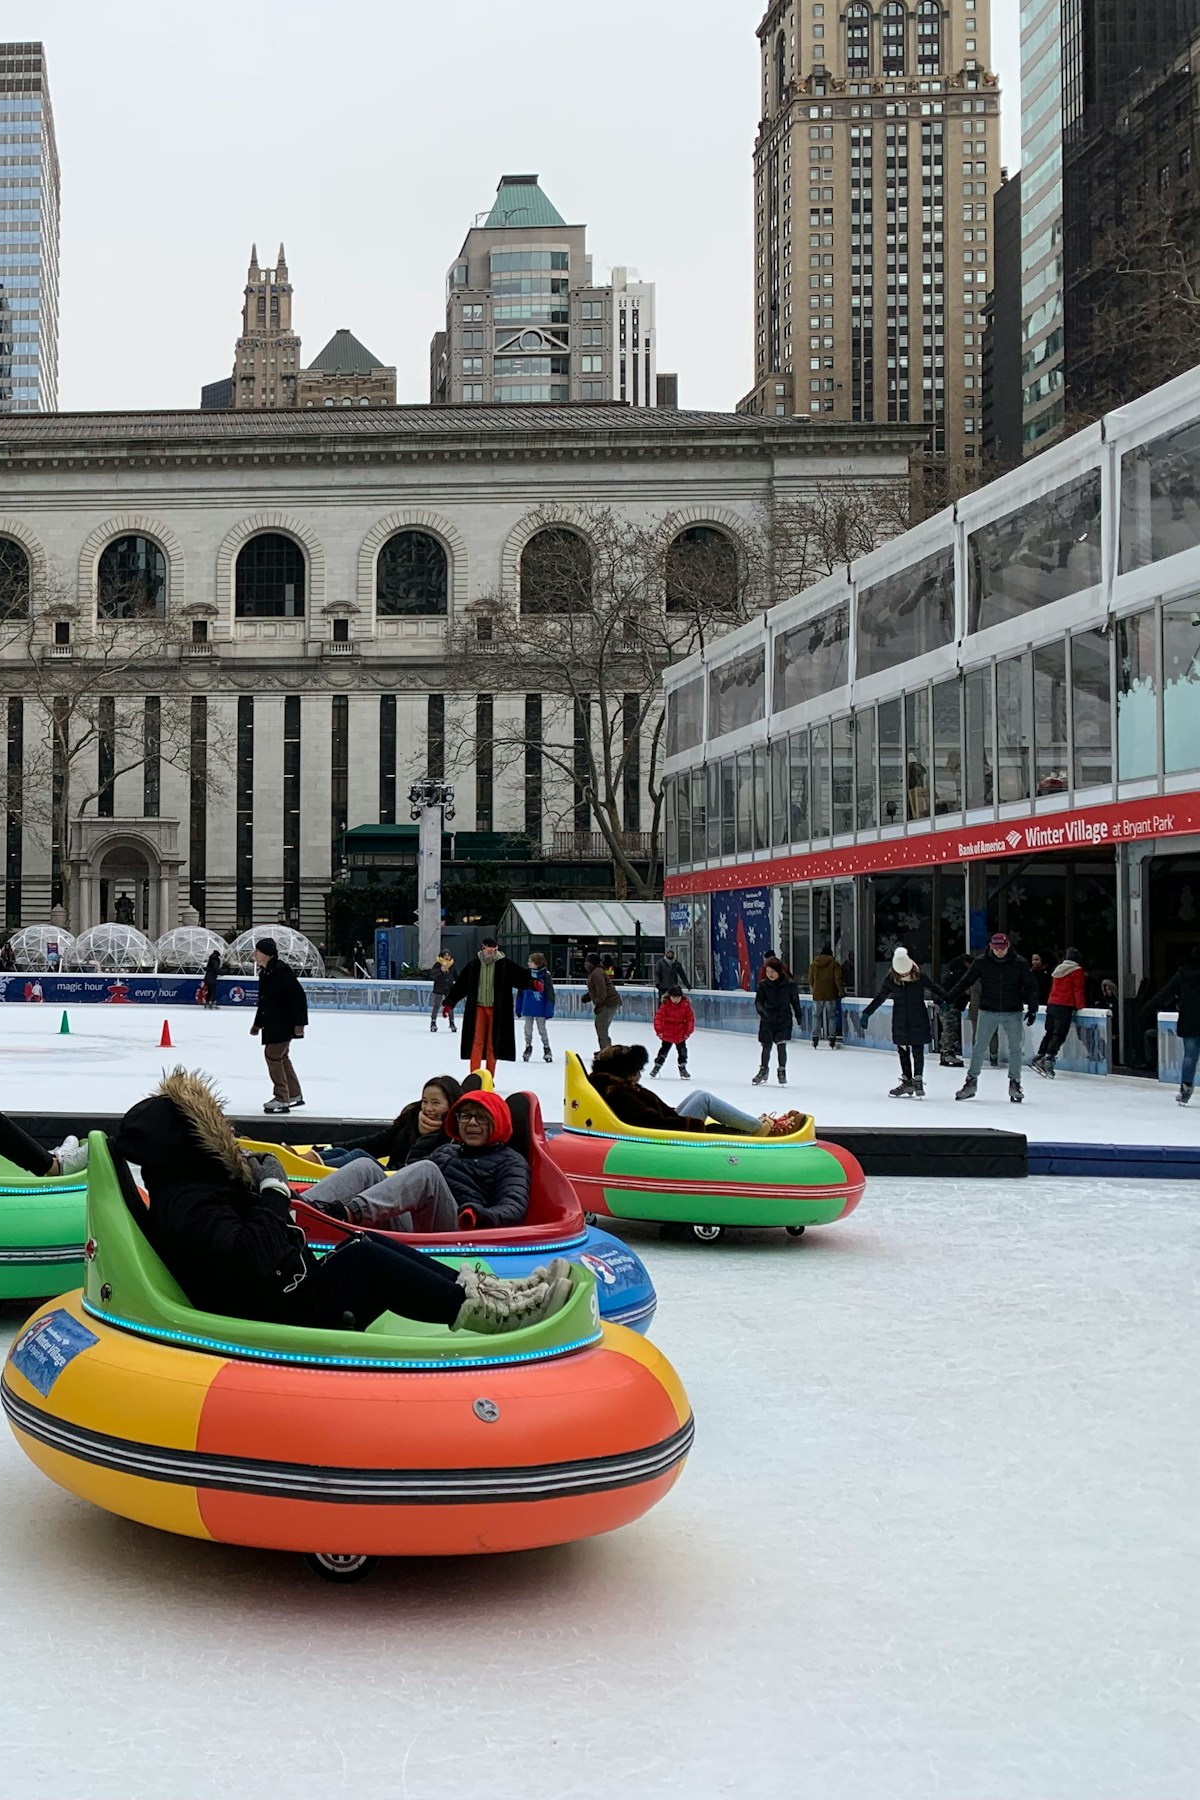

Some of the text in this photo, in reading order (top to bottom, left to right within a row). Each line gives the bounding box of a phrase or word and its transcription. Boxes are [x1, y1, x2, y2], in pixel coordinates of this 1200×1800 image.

[958, 813, 1174, 856] Bank of America Winter Village at Bryant Park
[57, 982, 103, 992] magic hour
[135, 988, 177, 998] every hour
[590, 1294, 596, 1326] 9
[47, 1344, 66, 1366] Village
